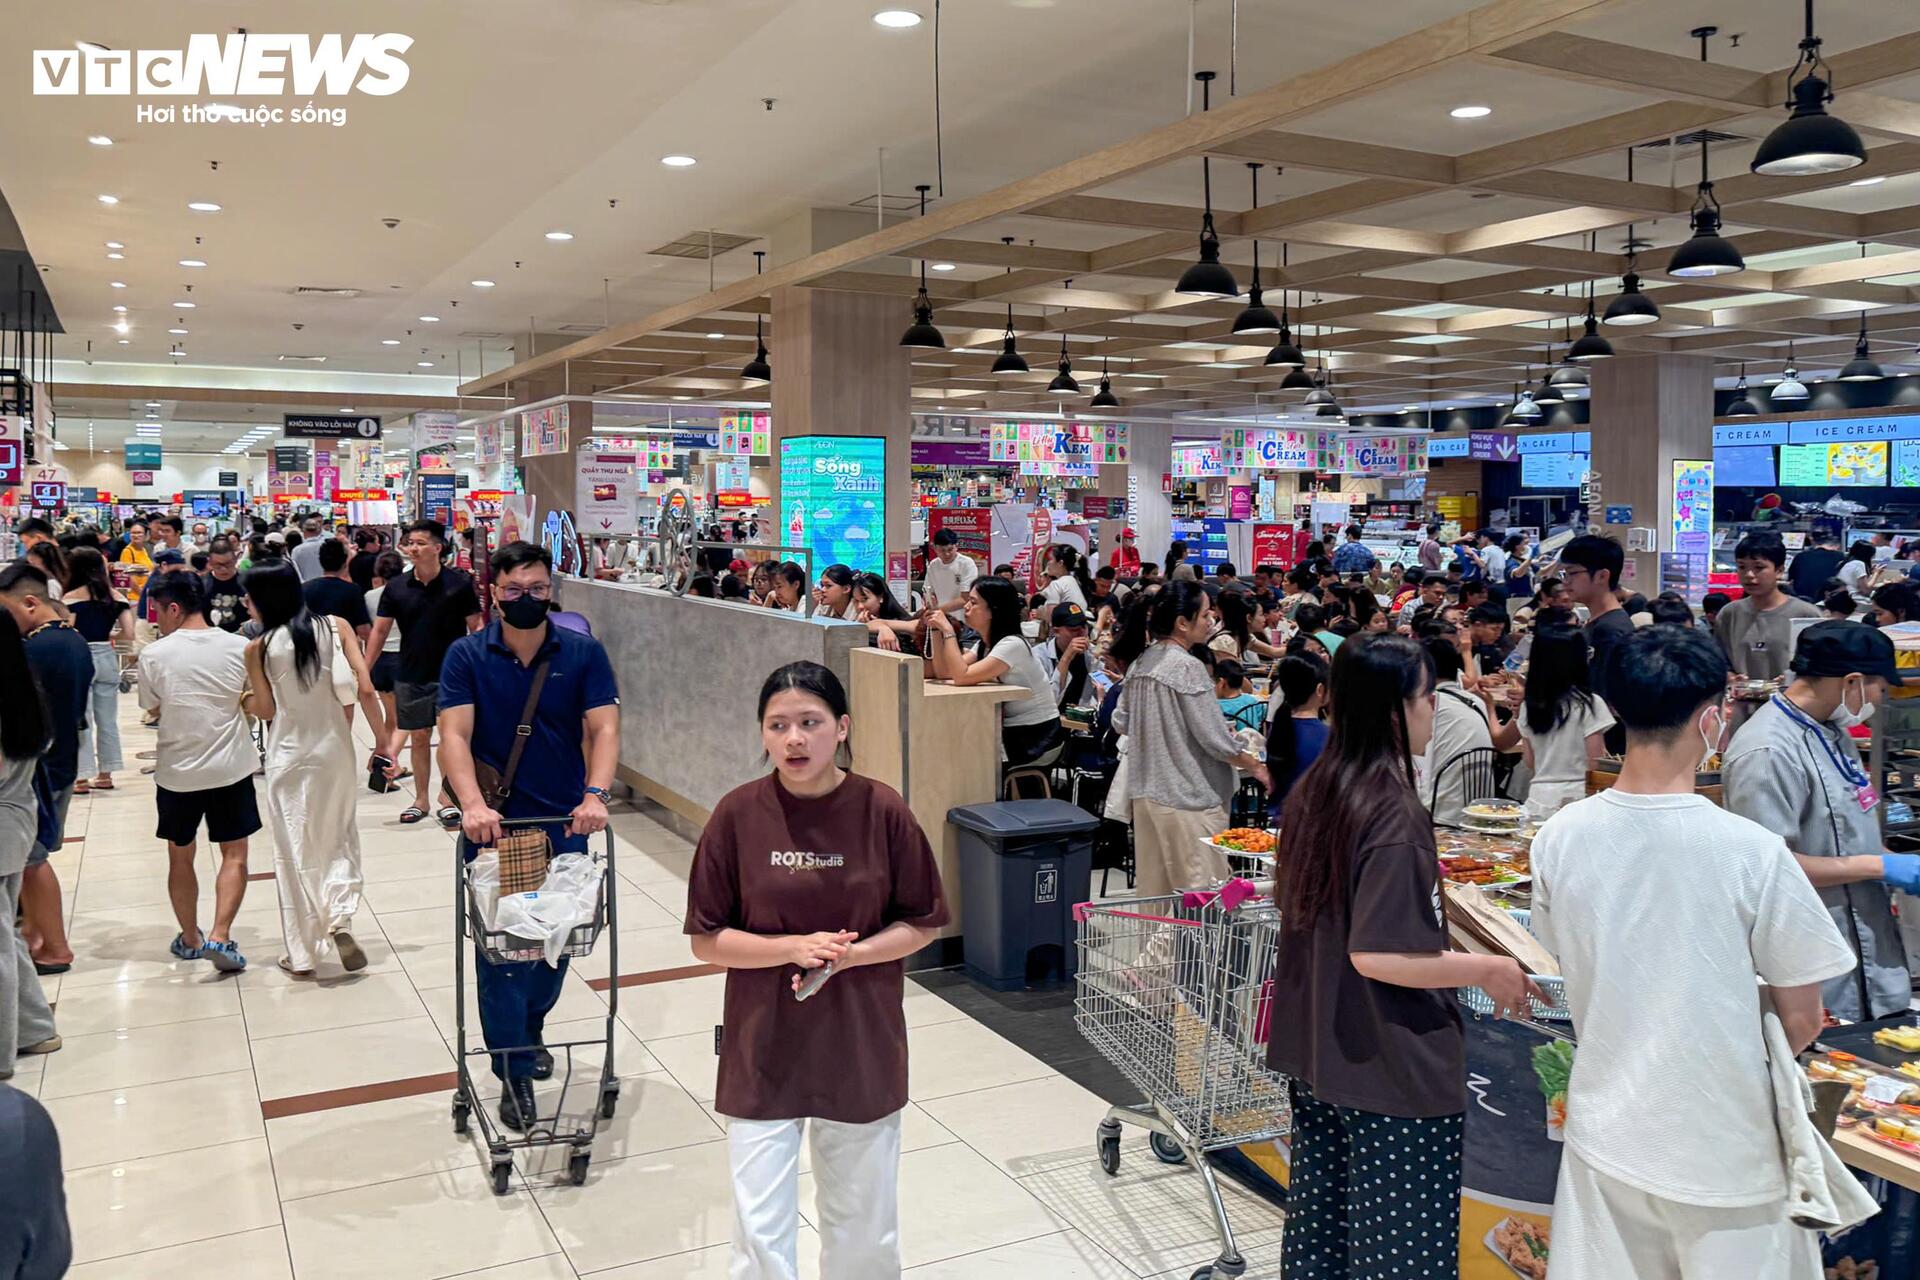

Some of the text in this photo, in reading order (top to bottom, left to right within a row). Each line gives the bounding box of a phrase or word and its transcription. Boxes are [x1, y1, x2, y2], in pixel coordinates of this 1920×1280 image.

[288, 419, 314, 428] KHÔNG
[314, 419, 329, 429] VÀO
[342, 420, 357, 429] NÀY
[1815, 424, 1898, 437] ICE CREAM
[1728, 430, 1772, 440] CREAM
[1053, 432, 1090, 454] KEM
[1450, 443, 1466, 451] CAF
[815, 455, 862, 477] Sống
[38, 469, 57, 480] 47
[833, 475, 880, 492] Xanh
[1588, 470, 1602, 516] AEON
[1127, 475, 1138, 529] PROMO
